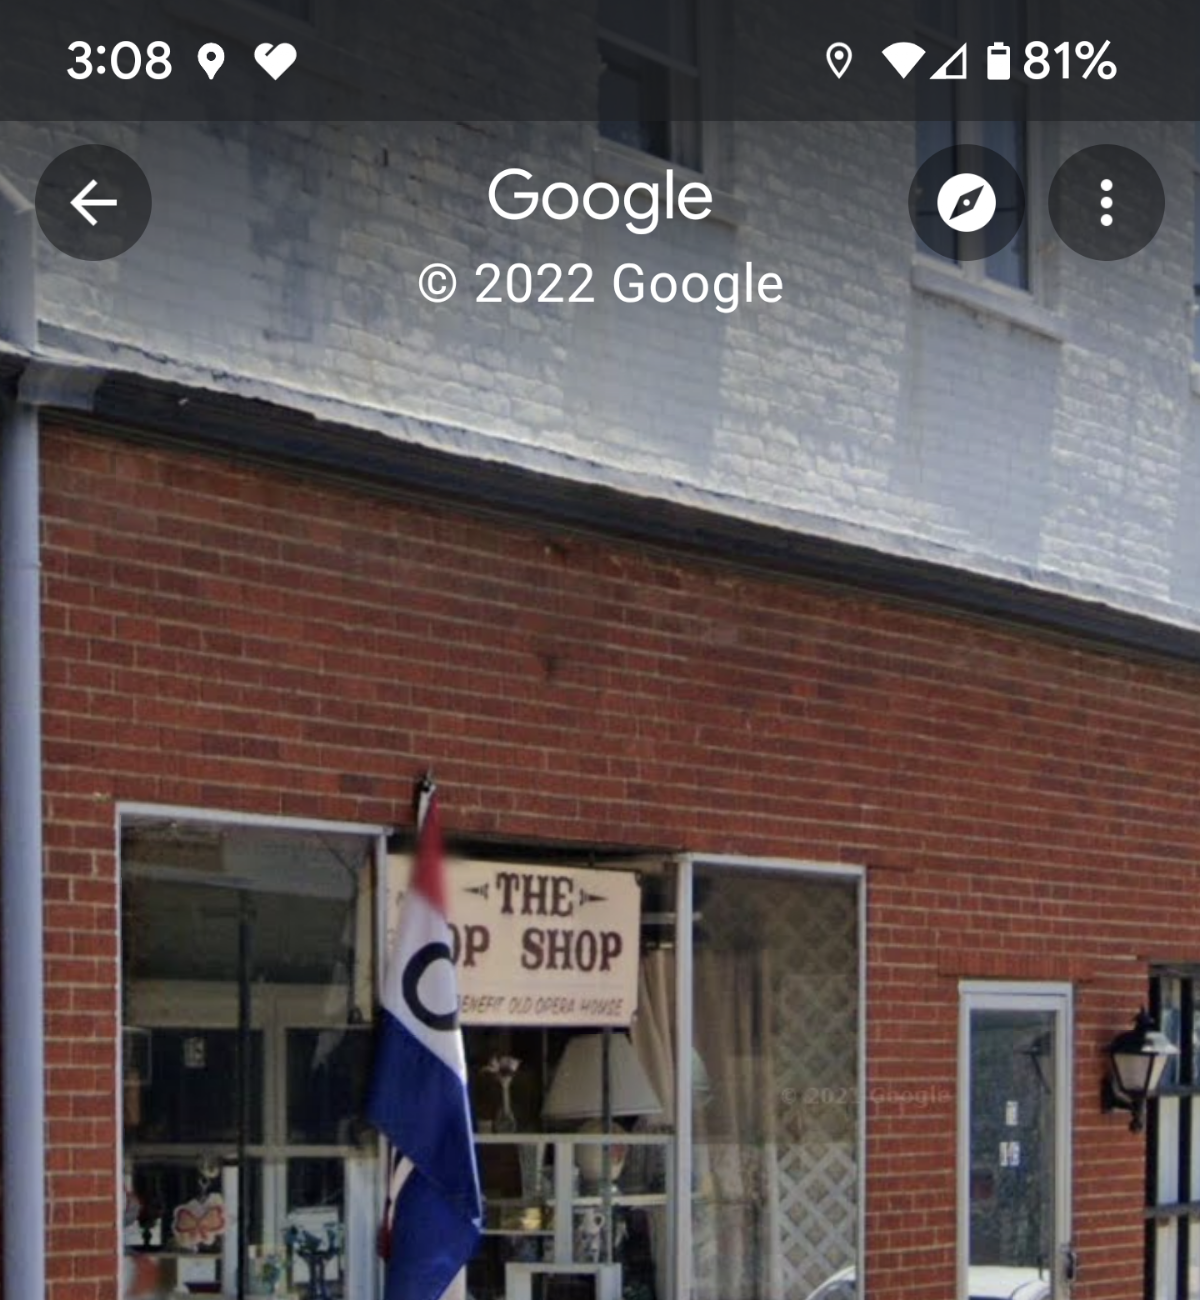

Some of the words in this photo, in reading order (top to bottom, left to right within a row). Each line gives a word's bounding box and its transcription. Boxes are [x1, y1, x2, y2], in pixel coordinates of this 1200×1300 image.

[495, 871, 574, 918] THE
[520, 926, 623, 973] SHOP
[457, 994, 505, 1014] ENEFIT
